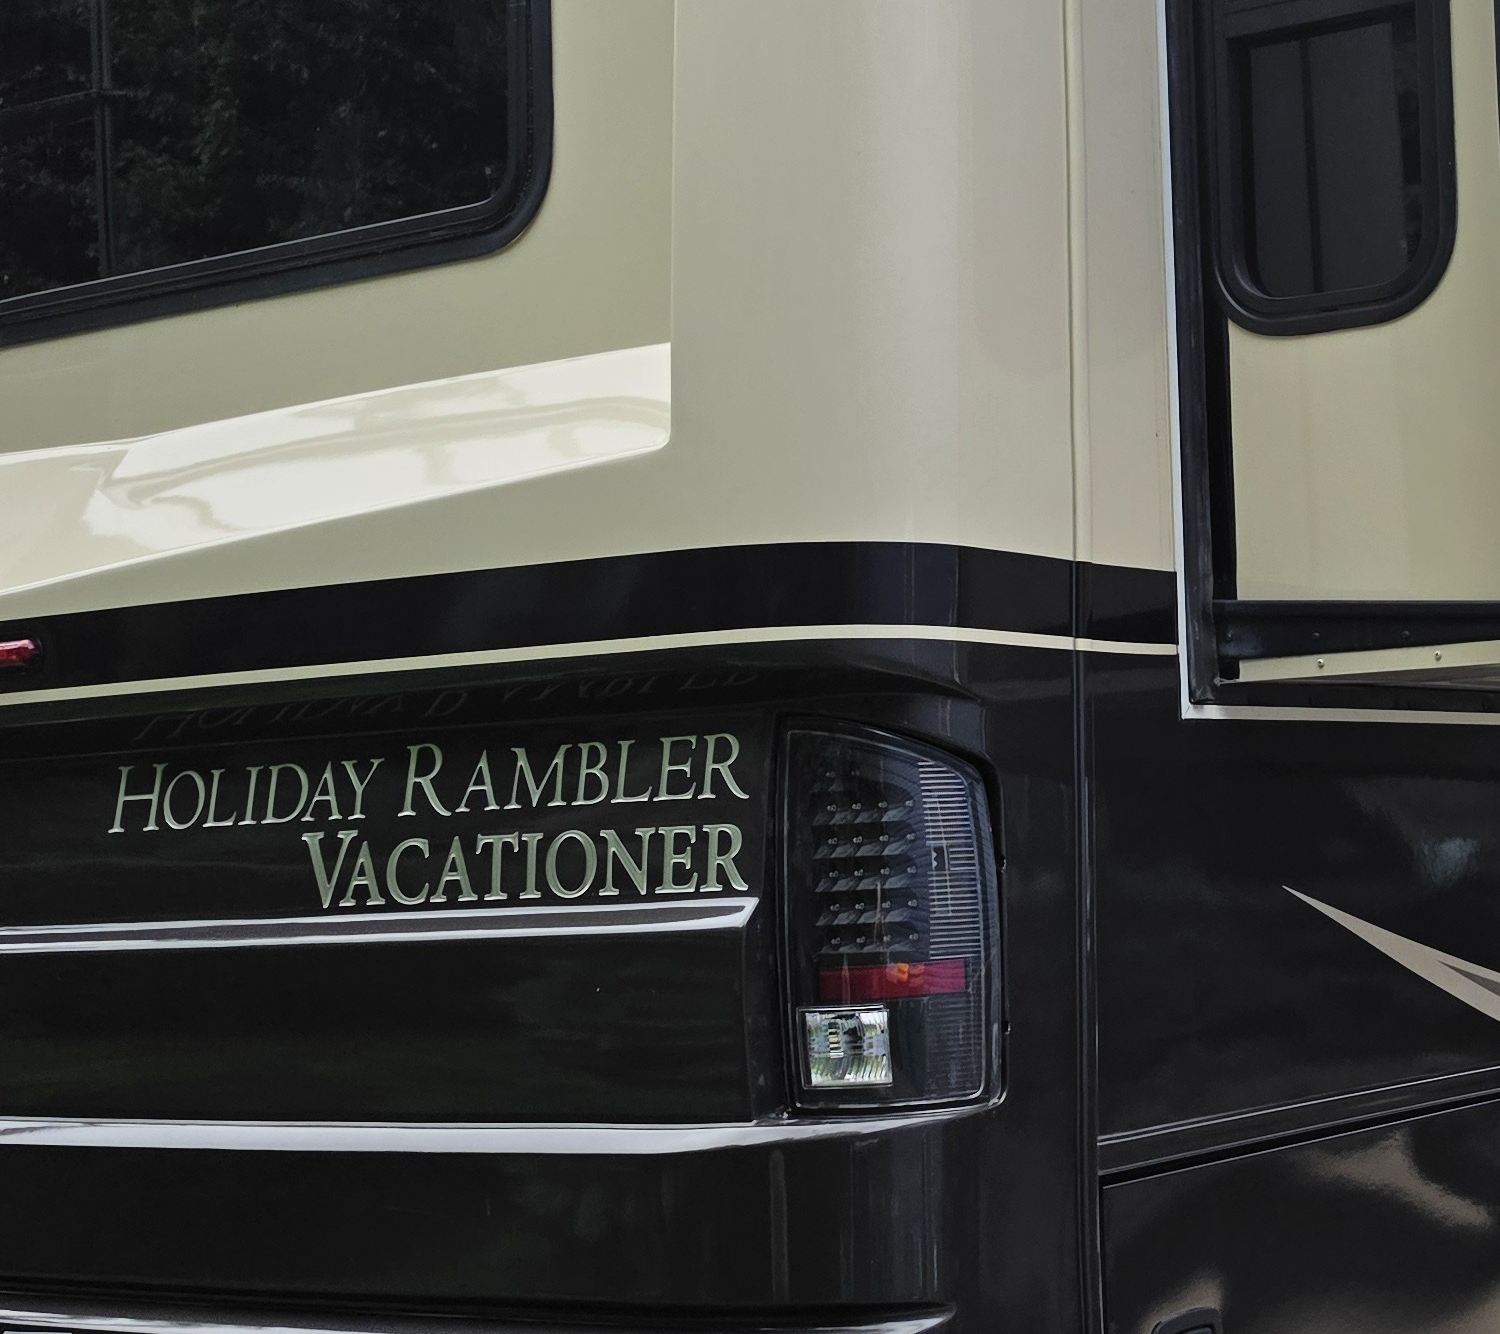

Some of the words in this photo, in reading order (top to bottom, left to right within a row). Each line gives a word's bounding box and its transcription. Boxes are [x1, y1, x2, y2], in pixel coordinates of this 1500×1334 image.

[108, 757, 385, 834] HOLIDAY
[398, 733, 750, 817] RAMBLER
[301, 823, 749, 908] VACATIONER
